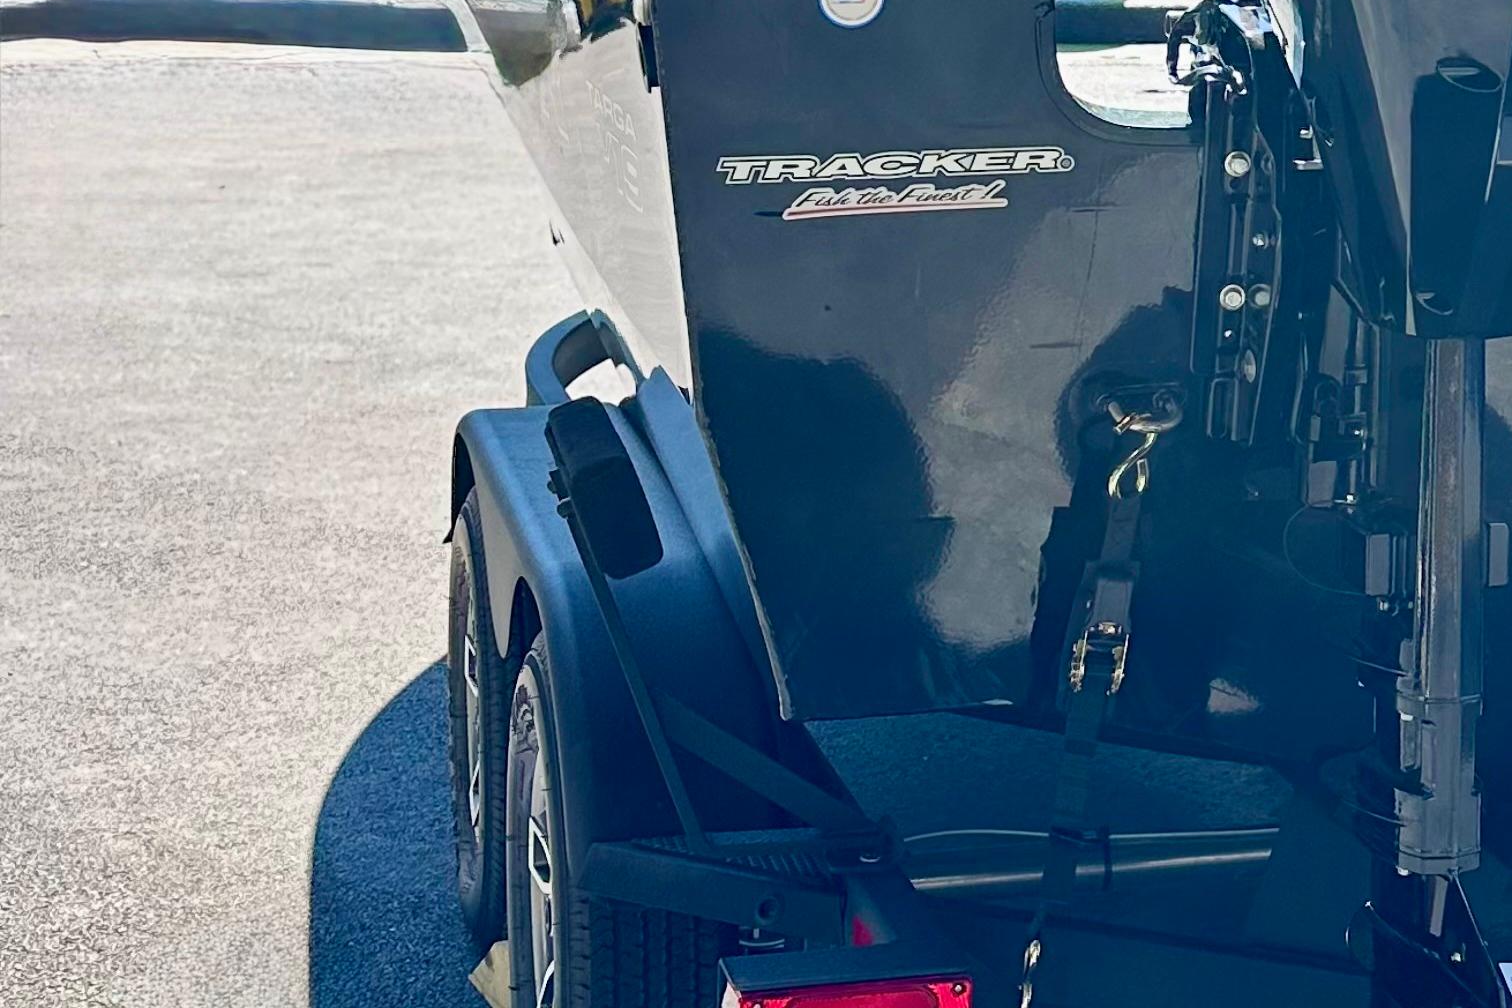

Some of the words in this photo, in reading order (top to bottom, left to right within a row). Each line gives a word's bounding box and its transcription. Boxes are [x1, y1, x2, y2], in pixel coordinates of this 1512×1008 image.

[586, 79, 637, 141] TARGA
[717, 147, 1066, 185] TRACKER
[796, 188, 850, 207] Fish
[856, 188, 895, 206] the
